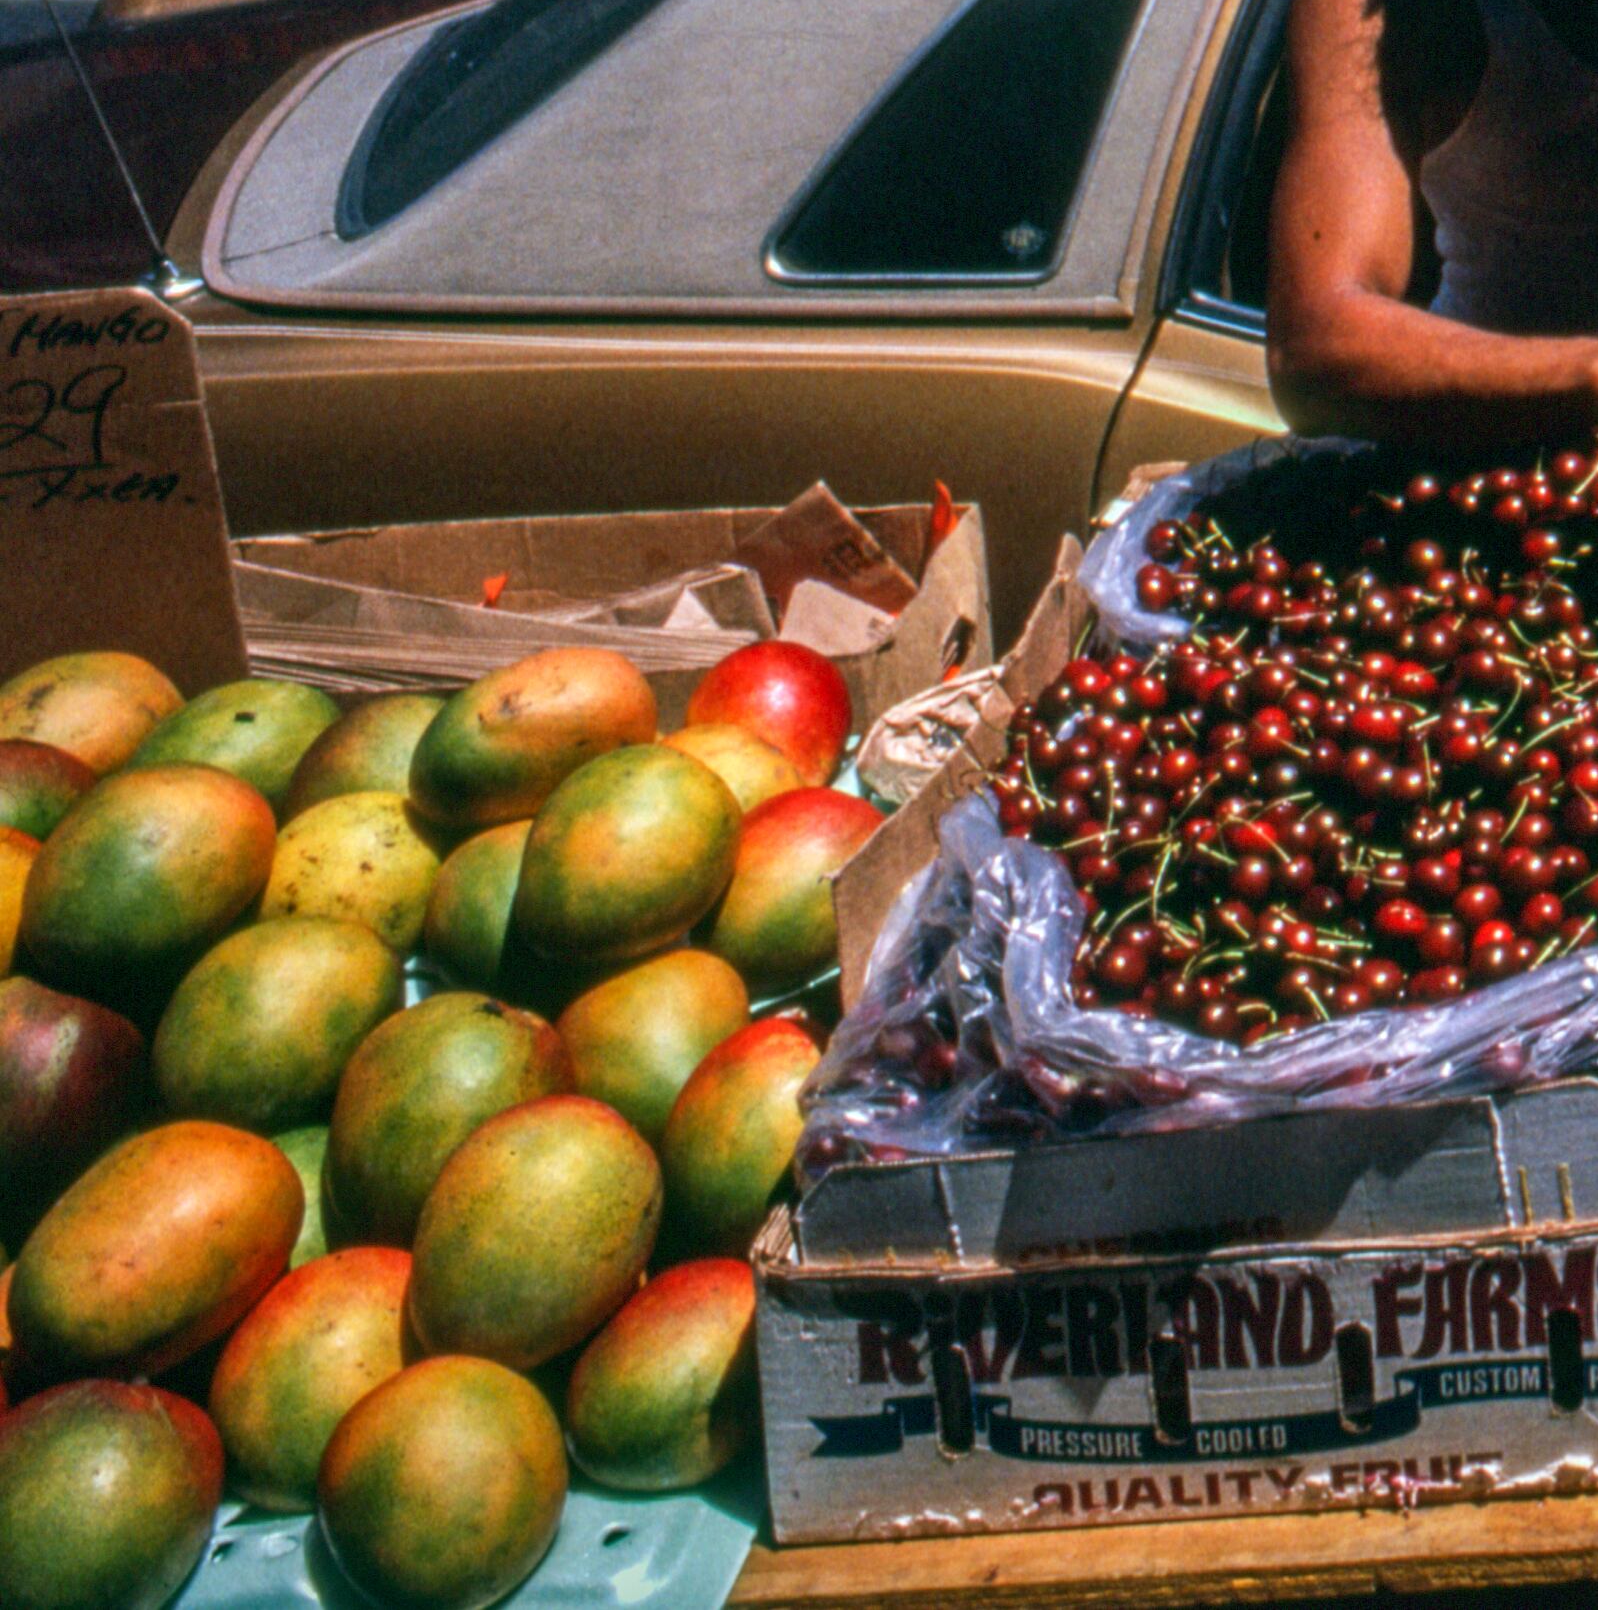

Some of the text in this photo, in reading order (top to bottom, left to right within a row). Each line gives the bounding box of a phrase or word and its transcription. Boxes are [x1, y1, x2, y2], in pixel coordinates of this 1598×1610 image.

[1440, 1364, 1540, 1396] CUSTOM
[1021, 1425, 1288, 1459] PRESSURE COOLED
[1033, 1465, 1305, 1515] QUALITY
